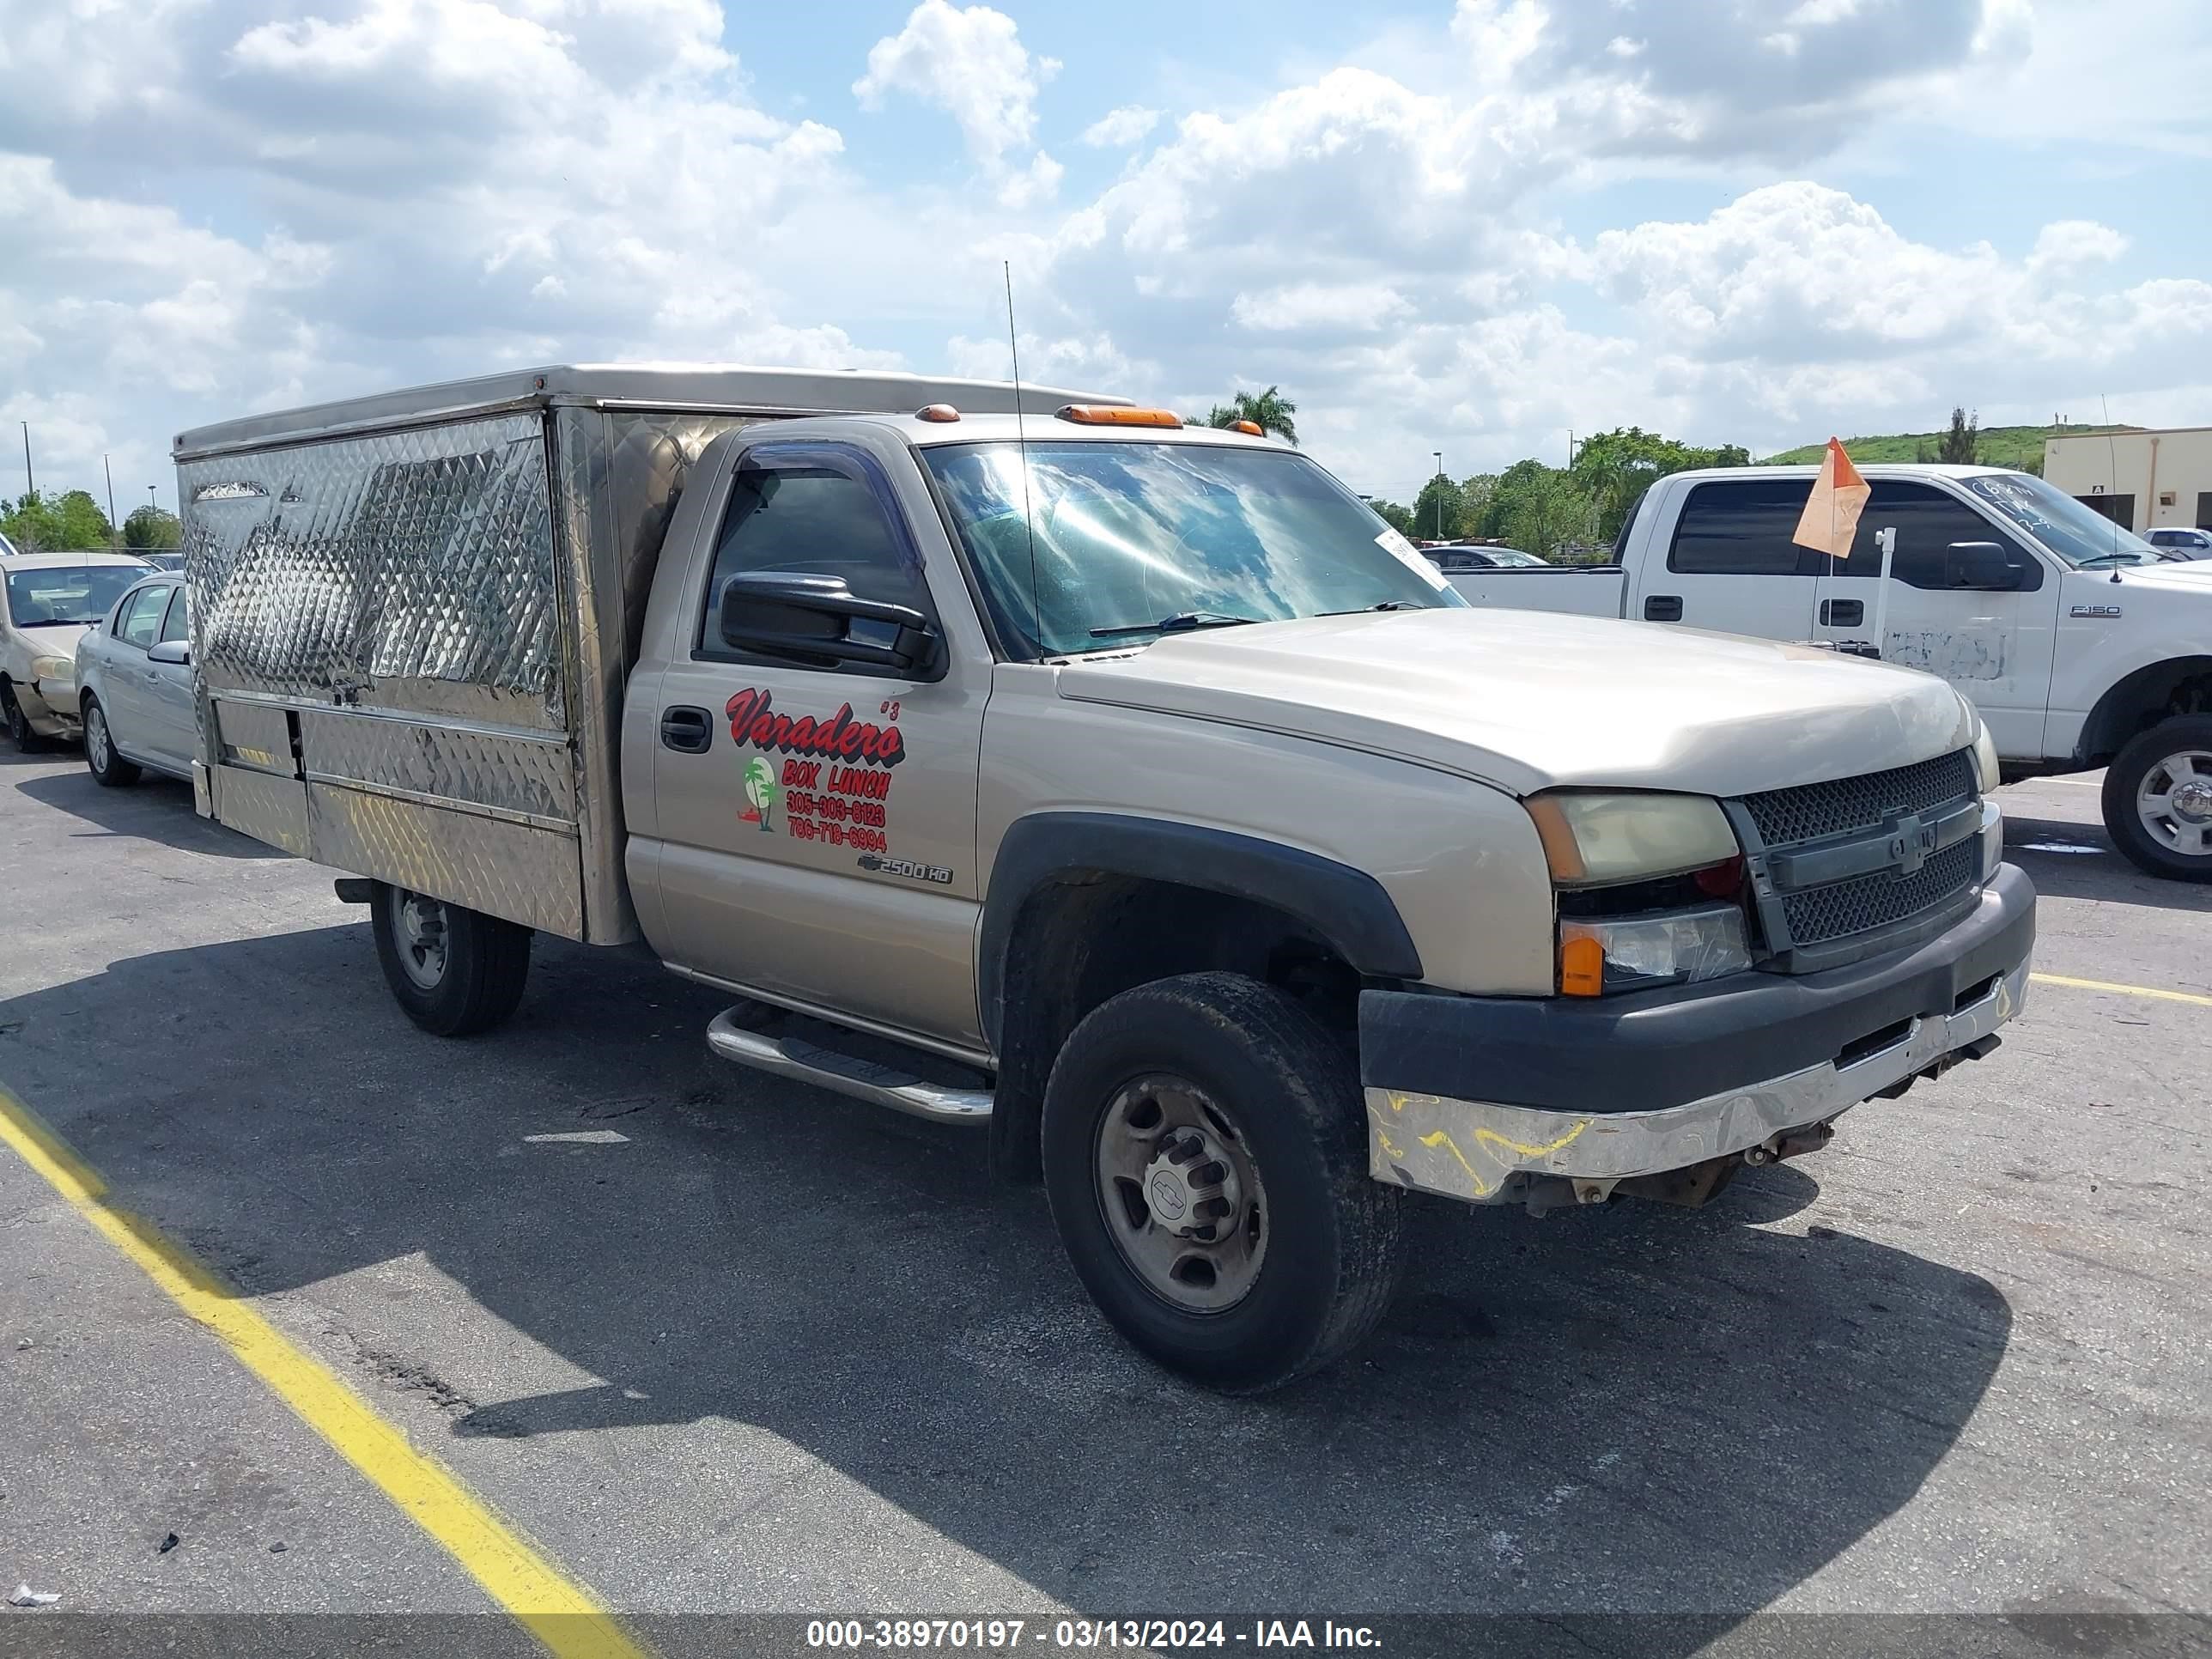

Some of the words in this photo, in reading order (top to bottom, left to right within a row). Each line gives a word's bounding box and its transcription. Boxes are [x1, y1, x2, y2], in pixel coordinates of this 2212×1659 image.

[726, 687, 906, 769] Varadero
[781, 758, 822, 790] BOX
[827, 765, 891, 801] LUNCH
[786, 790, 885, 828] 305-303-8123
[787, 815, 887, 854] 786-718-6994
[879, 858, 927, 879] 2500
[928, 866, 951, 883] HD
